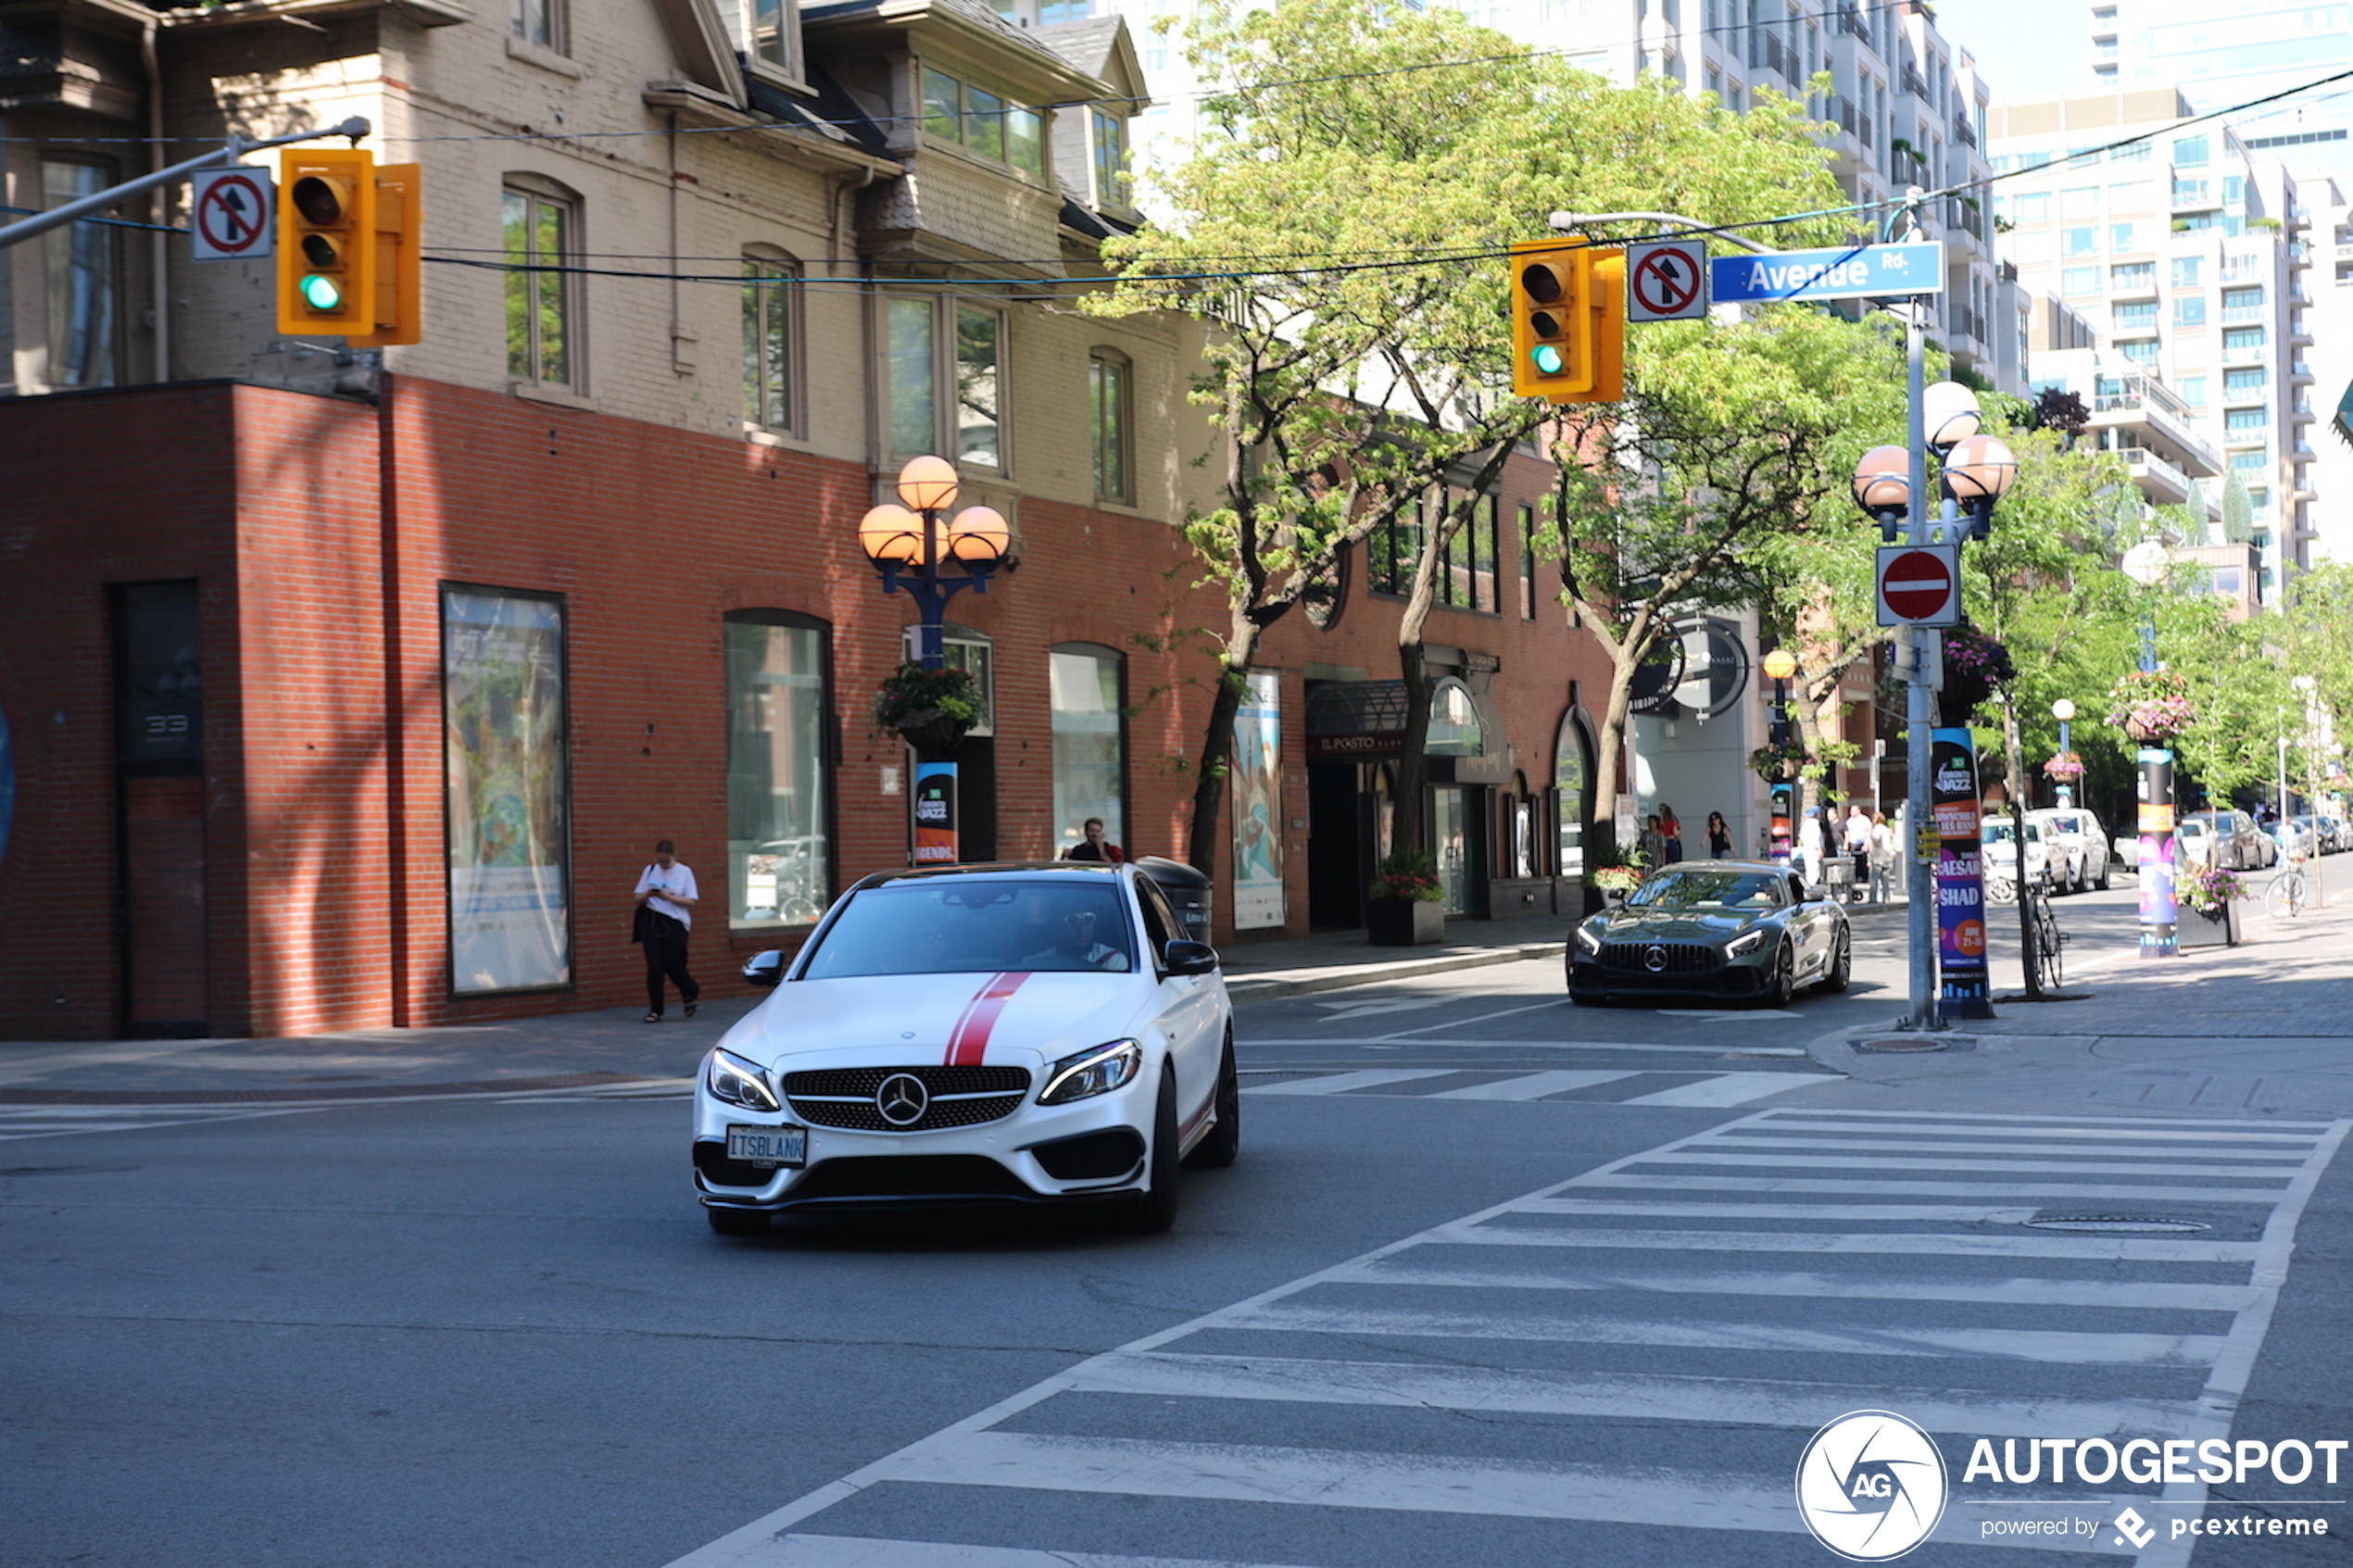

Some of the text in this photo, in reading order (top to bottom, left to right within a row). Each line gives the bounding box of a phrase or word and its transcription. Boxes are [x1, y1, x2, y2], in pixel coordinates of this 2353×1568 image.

[1747, 260, 1869, 292] Avenue
[145, 715, 188, 733] 33
[1322, 738, 1332, 750] IL
[1333, 736, 1375, 750] POSTO
[1942, 779, 1971, 791] JAZZ
[1940, 886, 1979, 907] SHAD
[1964, 927, 1981, 936] JUNE
[731, 1135, 803, 1158] ITSBLANK
